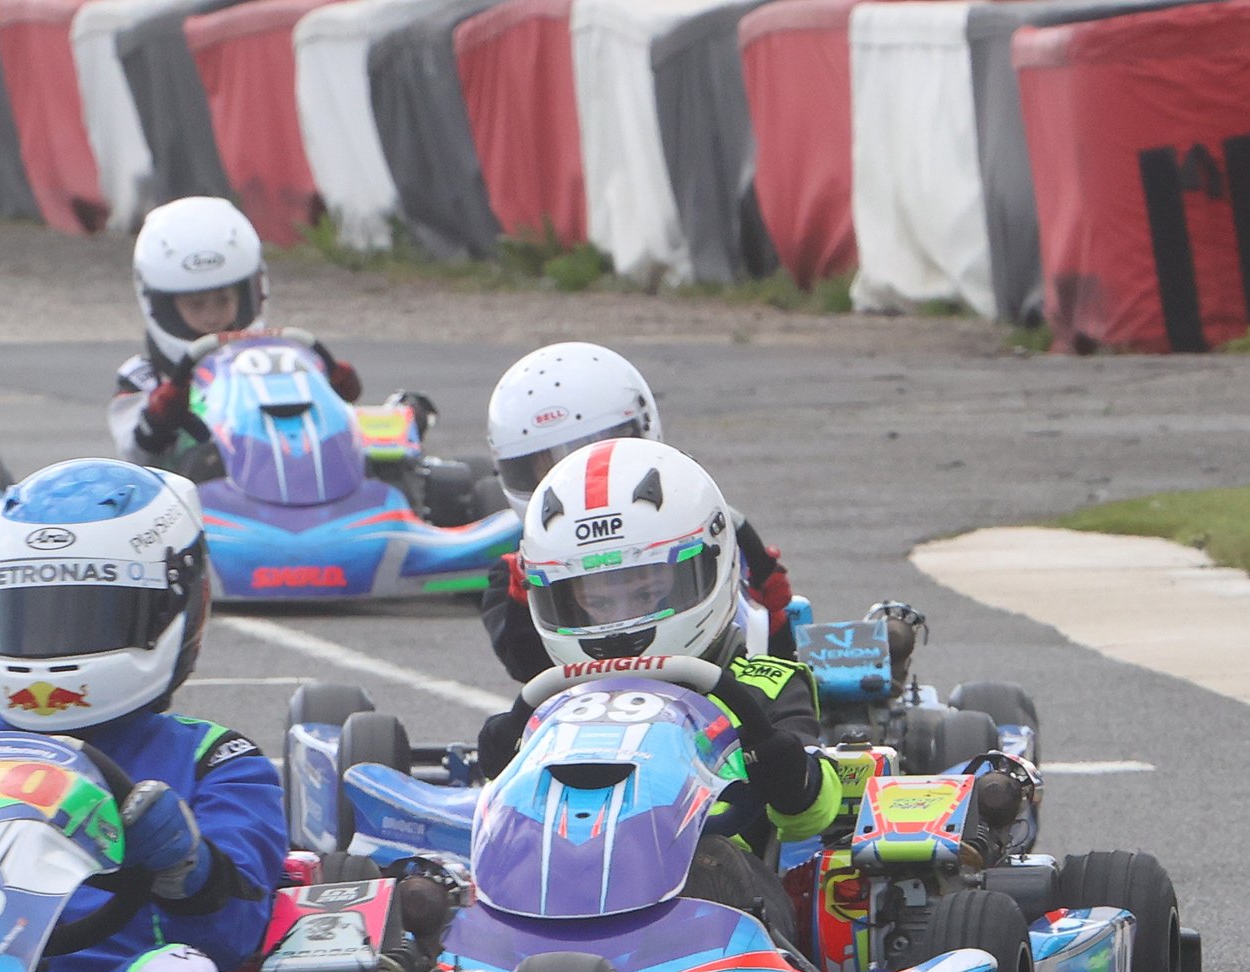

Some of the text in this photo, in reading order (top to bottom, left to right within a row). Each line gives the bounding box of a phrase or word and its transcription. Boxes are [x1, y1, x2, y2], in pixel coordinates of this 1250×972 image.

[234, 346, 295, 374] 07
[535, 410, 564, 423] BELL
[575, 517, 623, 541] OMP
[563, 655, 673, 679] WRIGHT
[742, 664, 784, 680] OMP
[554, 691, 666, 723] 89
